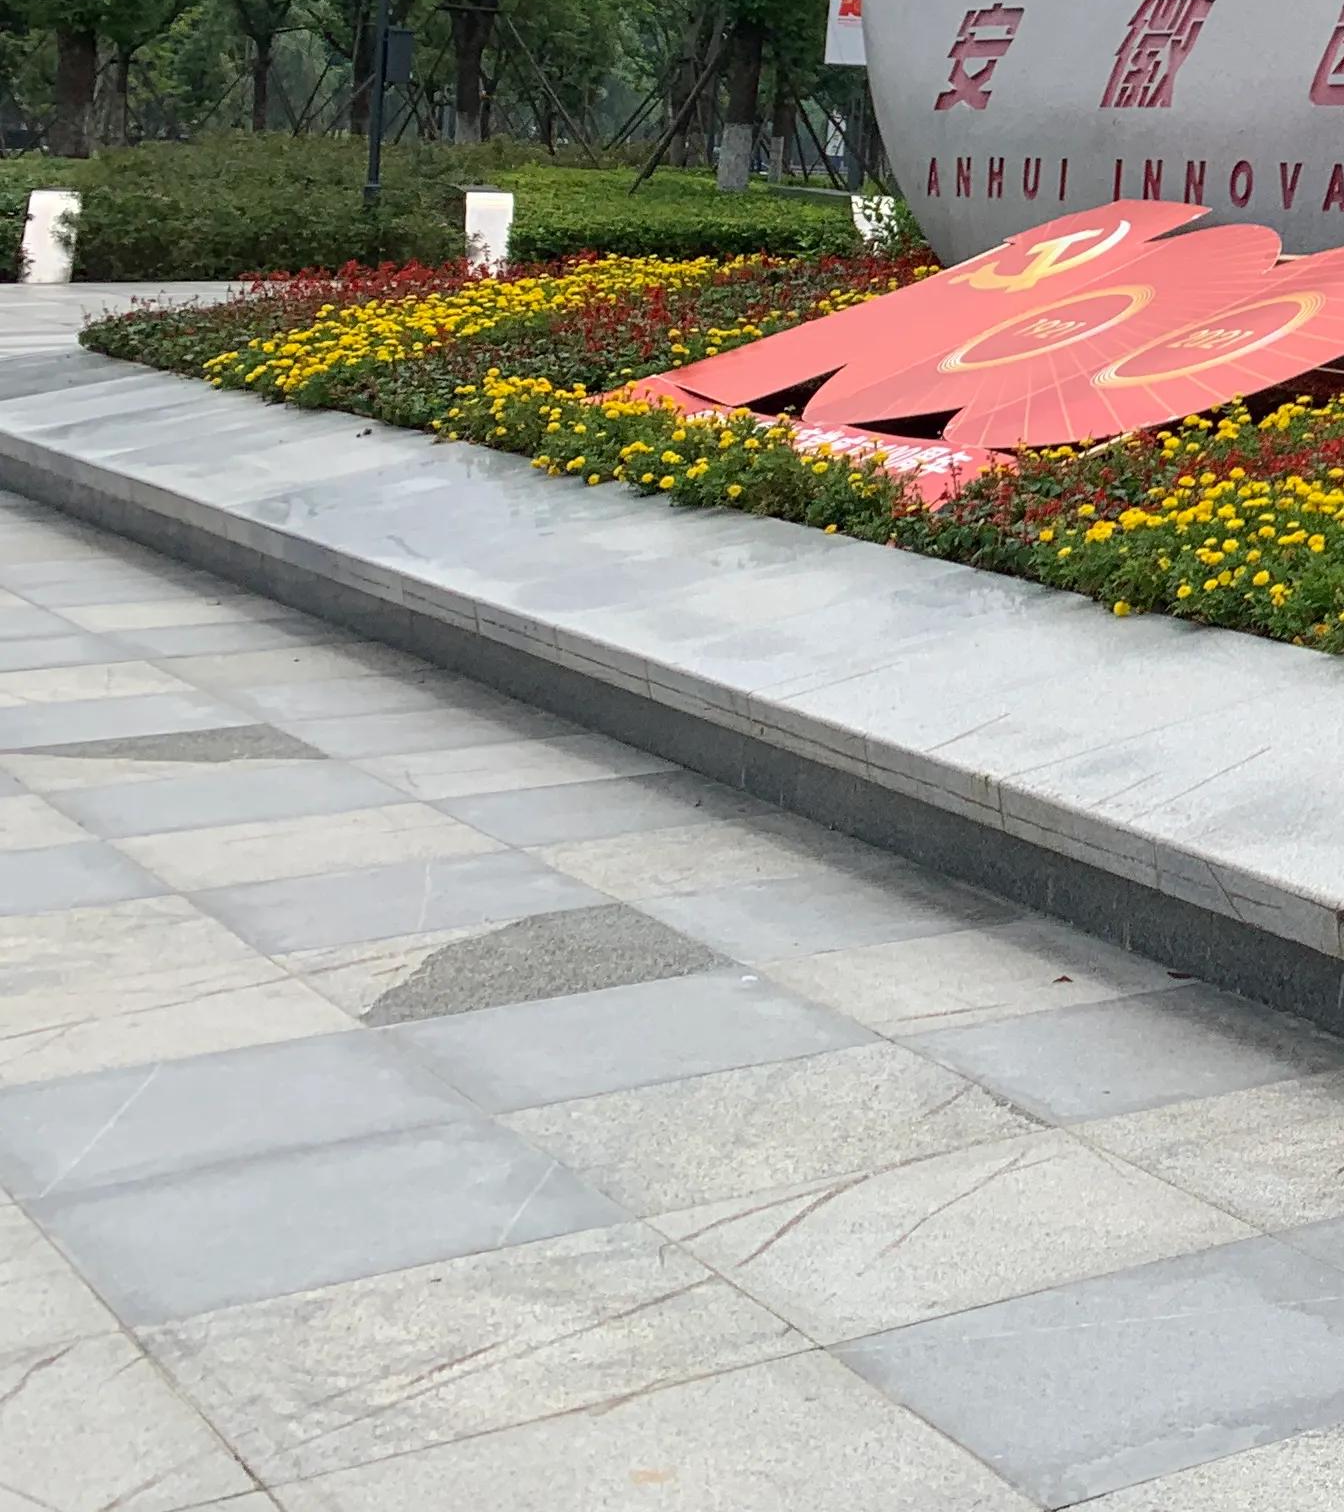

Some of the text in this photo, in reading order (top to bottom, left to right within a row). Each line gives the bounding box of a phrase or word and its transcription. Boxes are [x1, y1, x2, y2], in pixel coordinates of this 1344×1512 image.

[926, 156, 1070, 202] ANHUI
[1011, 317, 1088, 340] 1921
[1165, 328, 1256, 350] 2021
